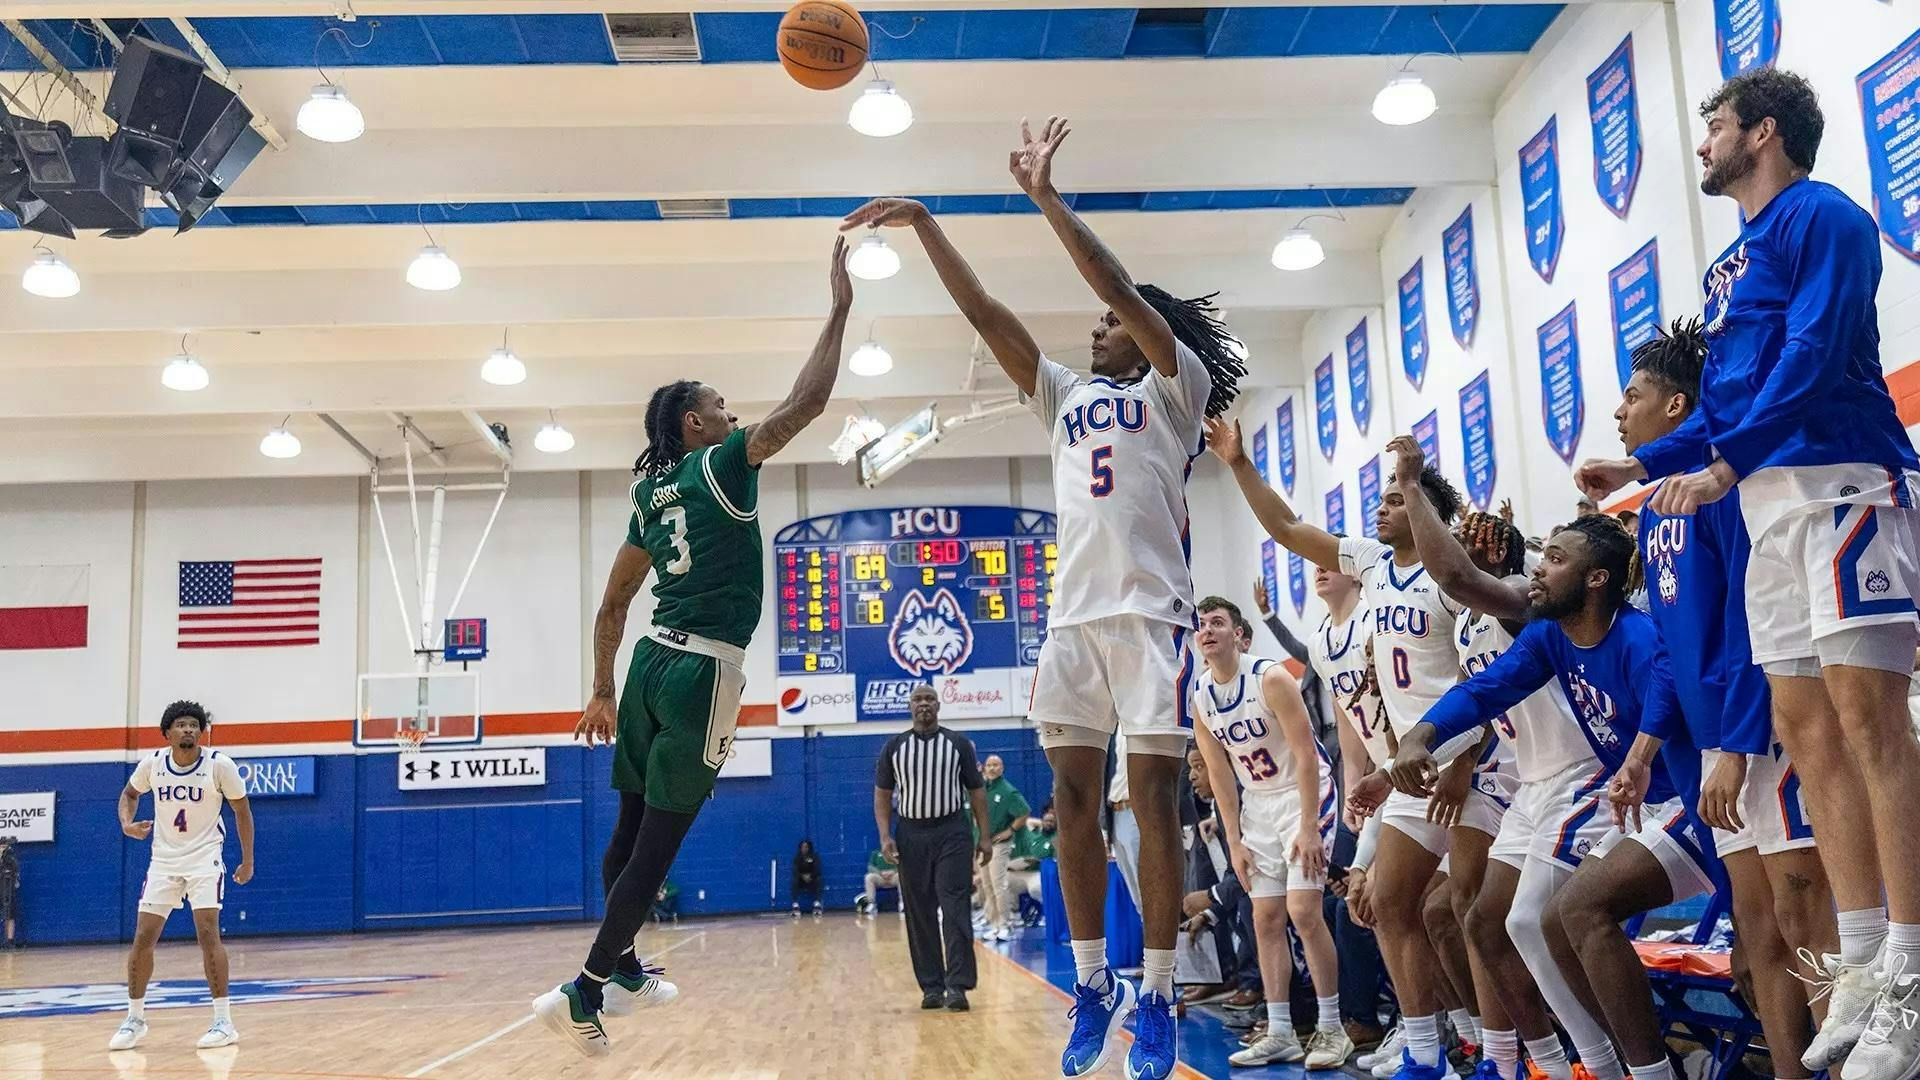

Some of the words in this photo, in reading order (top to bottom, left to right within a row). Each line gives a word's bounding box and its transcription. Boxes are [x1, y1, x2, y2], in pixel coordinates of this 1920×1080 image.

[1062, 397, 1147, 447] HCU
[1090, 445, 1113, 497] 5
[890, 508, 960, 537] HCU
[661, 506, 692, 575] 3
[969, 541, 1007, 552] VISITOR
[1647, 518, 1687, 565] HCU
[855, 554, 886, 580] 69
[922, 566, 936, 586] 2
[975, 551, 1007, 576] 70
[868, 599, 884, 624] 8
[989, 595, 1006, 620] 5
[1376, 605, 1429, 638] HCU
[804, 653, 818, 672] 2
[1393, 647, 1411, 689] 0
[811, 691, 855, 708] pepsi
[1213, 718, 1269, 748] HCU
[450, 761, 461, 778] I
[464, 758, 540, 778] WILL.
[1238, 748, 1279, 781] 23
[158, 785, 203, 802] HCU
[174, 809, 187, 833] 4
